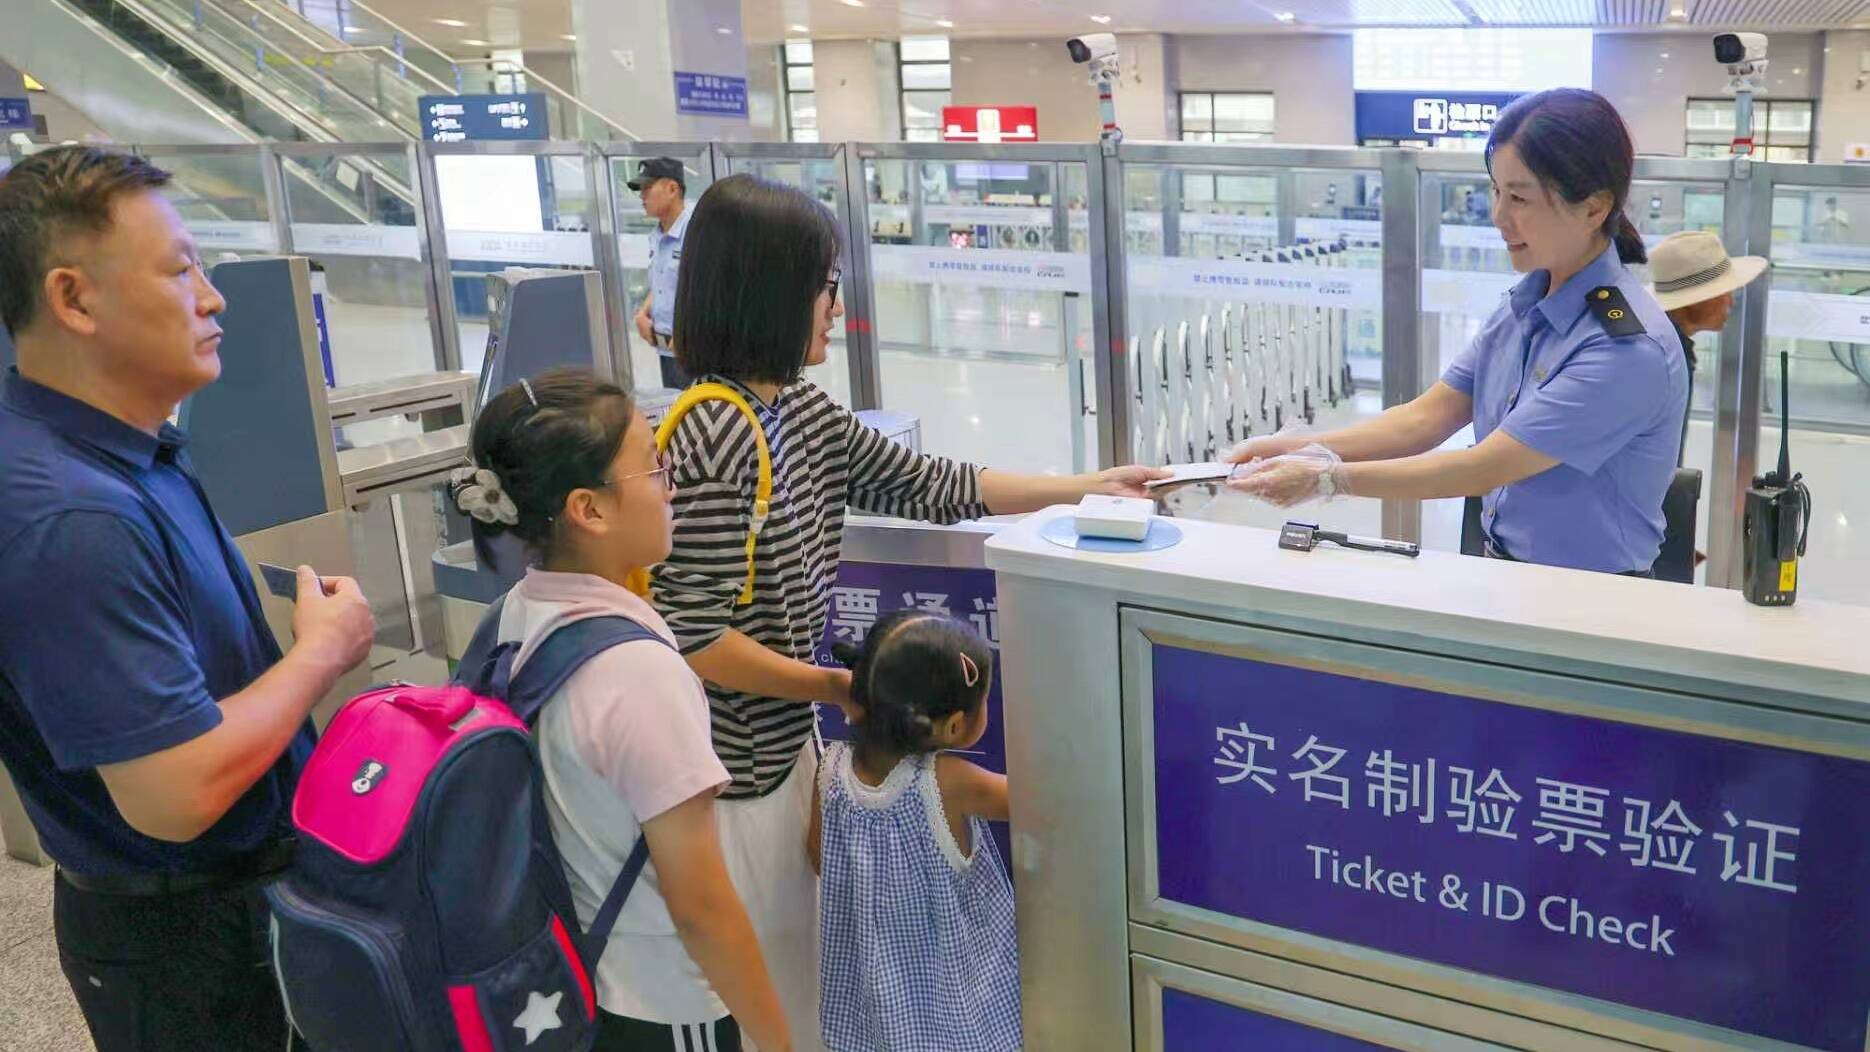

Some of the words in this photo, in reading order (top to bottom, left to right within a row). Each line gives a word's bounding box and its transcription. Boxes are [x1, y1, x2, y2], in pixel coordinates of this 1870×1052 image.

[1213, 721, 1801, 893] 实名制验票验证
[1306, 844, 1427, 903] Ticket
[1438, 873, 1469, 912] &
[1482, 881, 1526, 921] ID
[1538, 895, 1675, 956] Check
